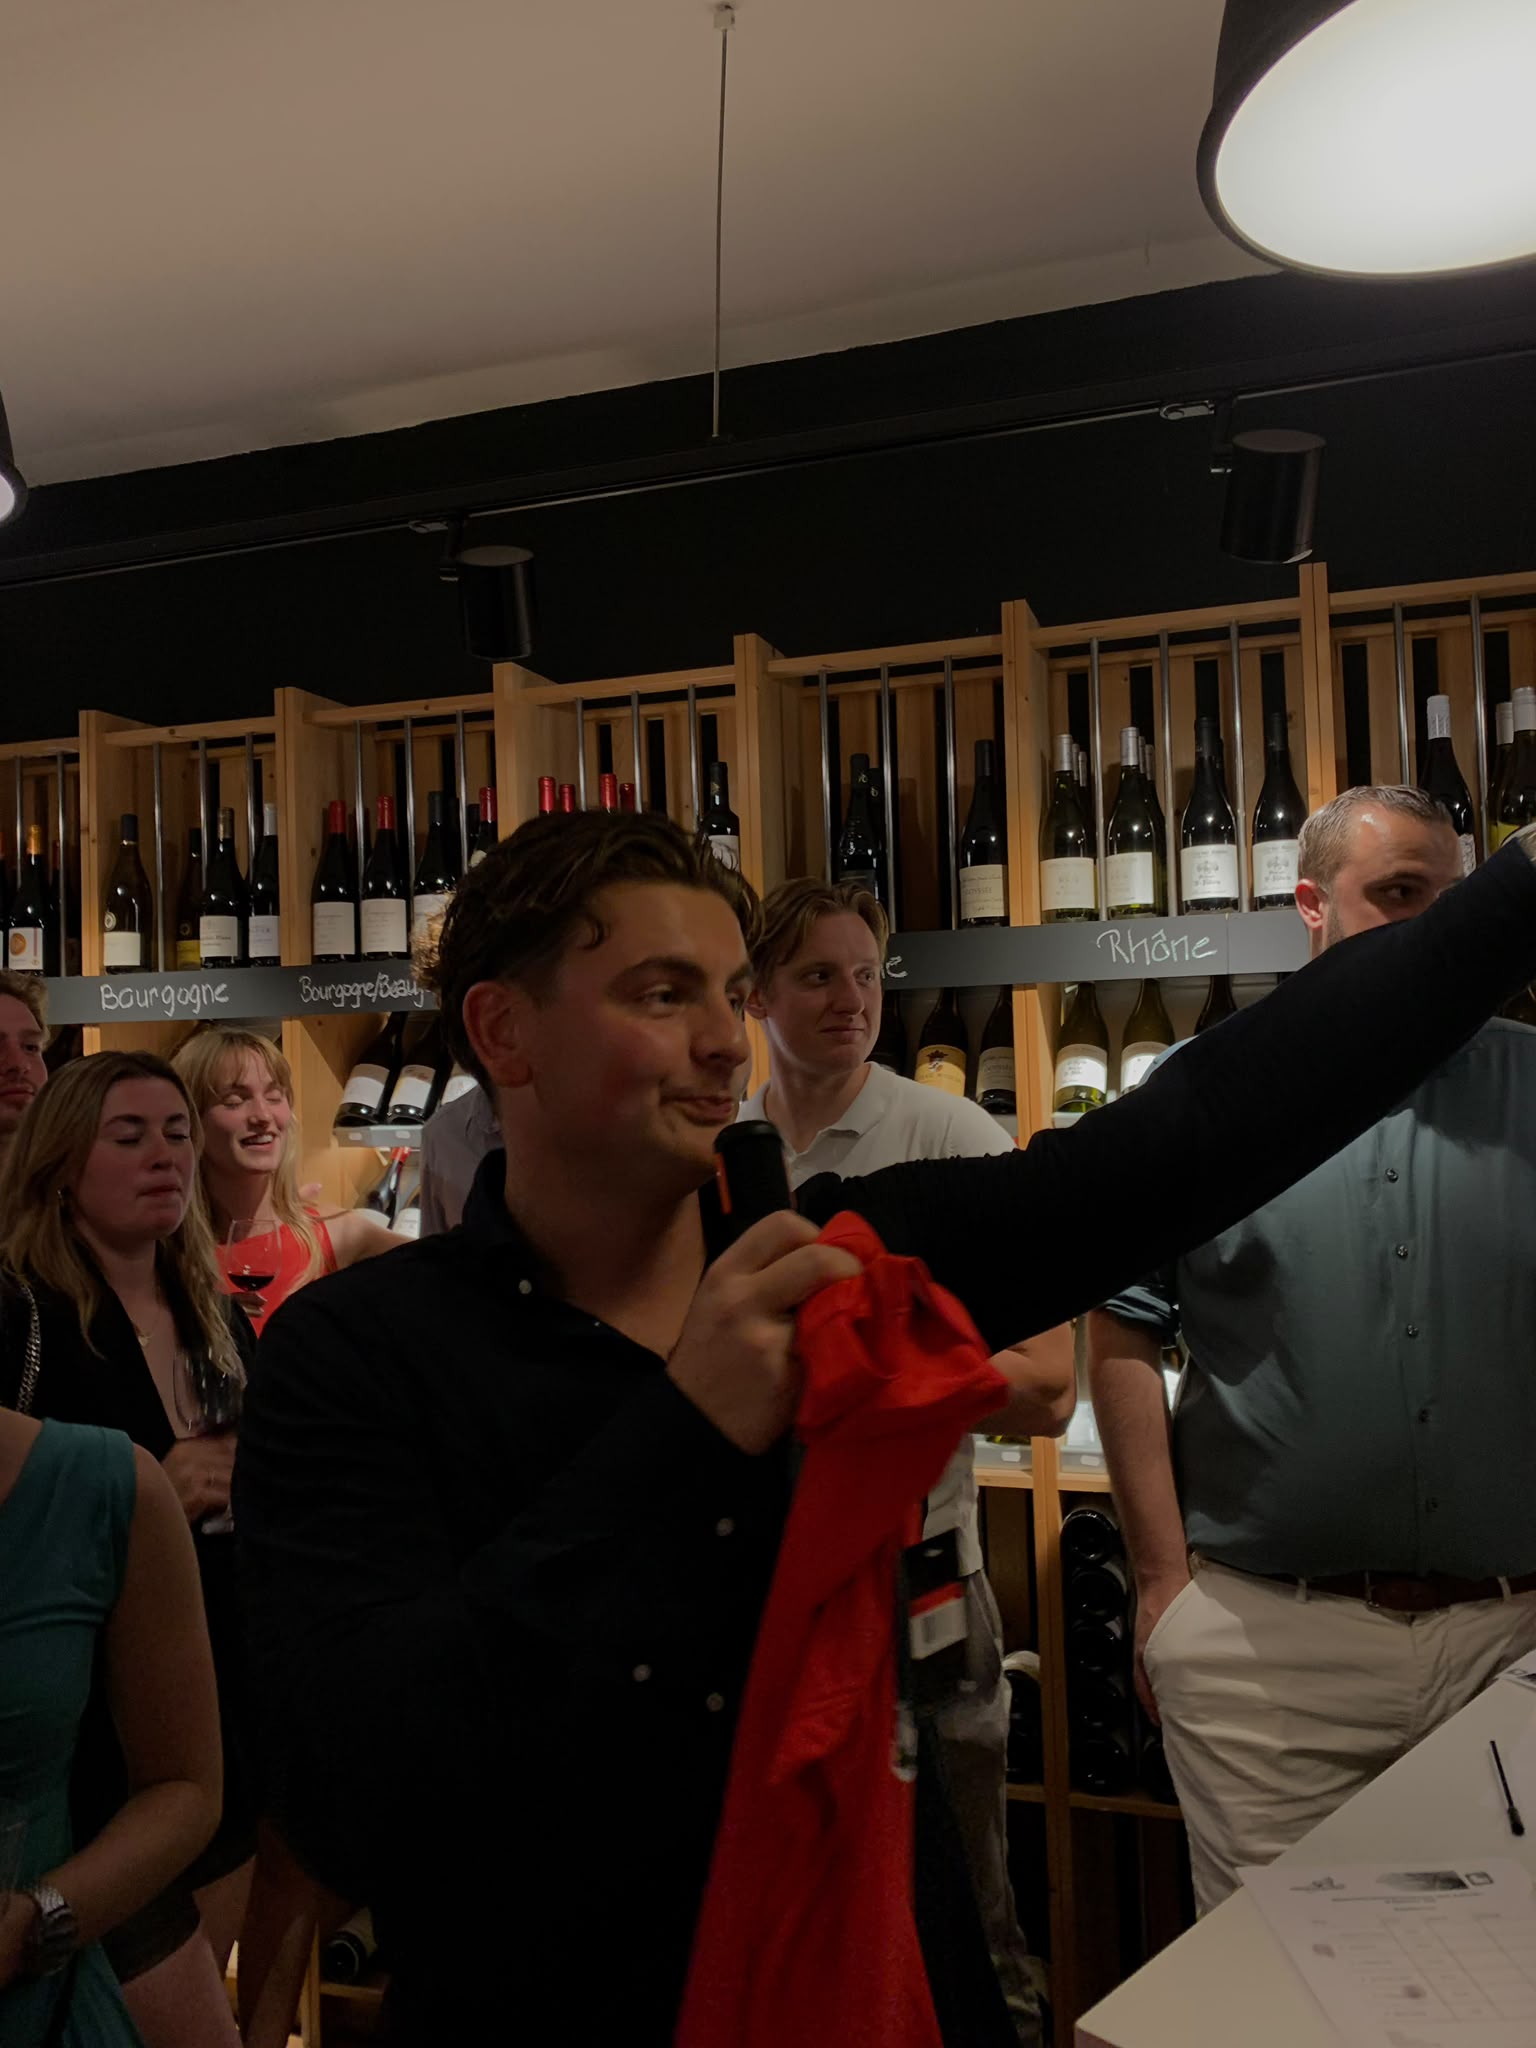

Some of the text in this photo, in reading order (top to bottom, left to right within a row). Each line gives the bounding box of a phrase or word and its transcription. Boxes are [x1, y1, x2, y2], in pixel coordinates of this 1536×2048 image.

[1097, 930, 1217, 966] Rhône
[100, 983, 229, 1016] Bourgogne
[299, 972, 430, 1008] Bourgogne/Beauj
